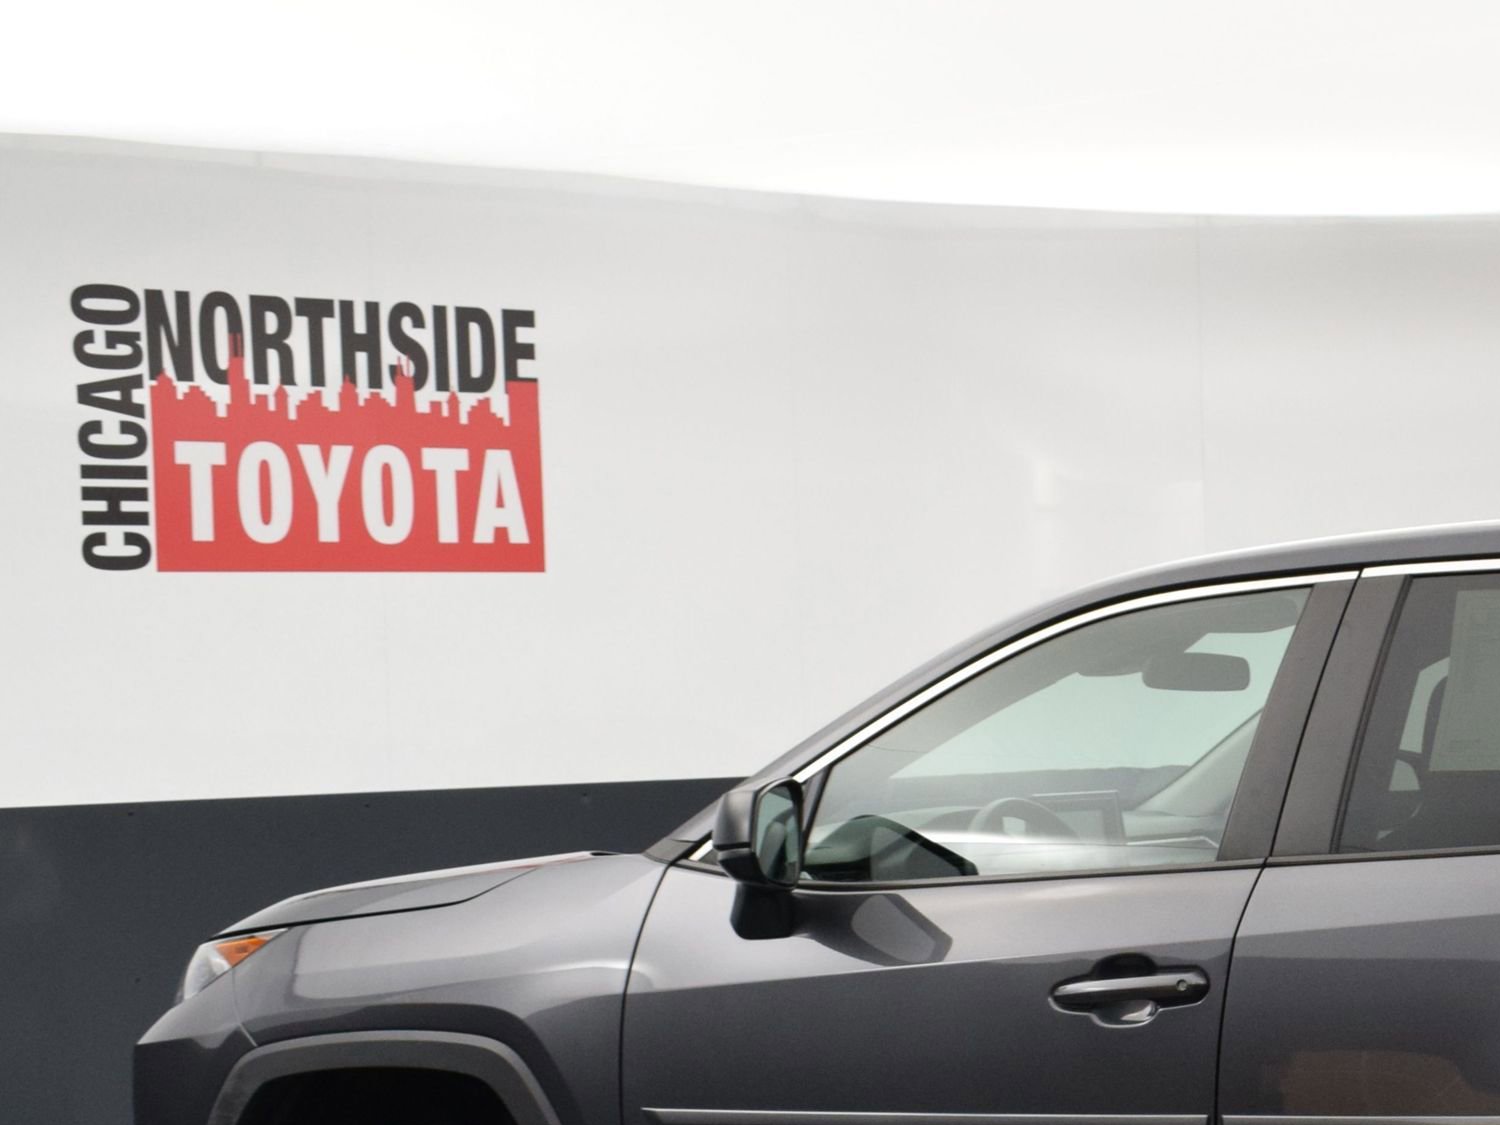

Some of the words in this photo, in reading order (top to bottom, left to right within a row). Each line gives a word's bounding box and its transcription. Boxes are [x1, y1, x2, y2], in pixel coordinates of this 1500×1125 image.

[143, 288, 538, 393] NORTHSIDE
[70, 283, 152, 571] CHICAGO
[173, 440, 531, 545] TOYOTA
